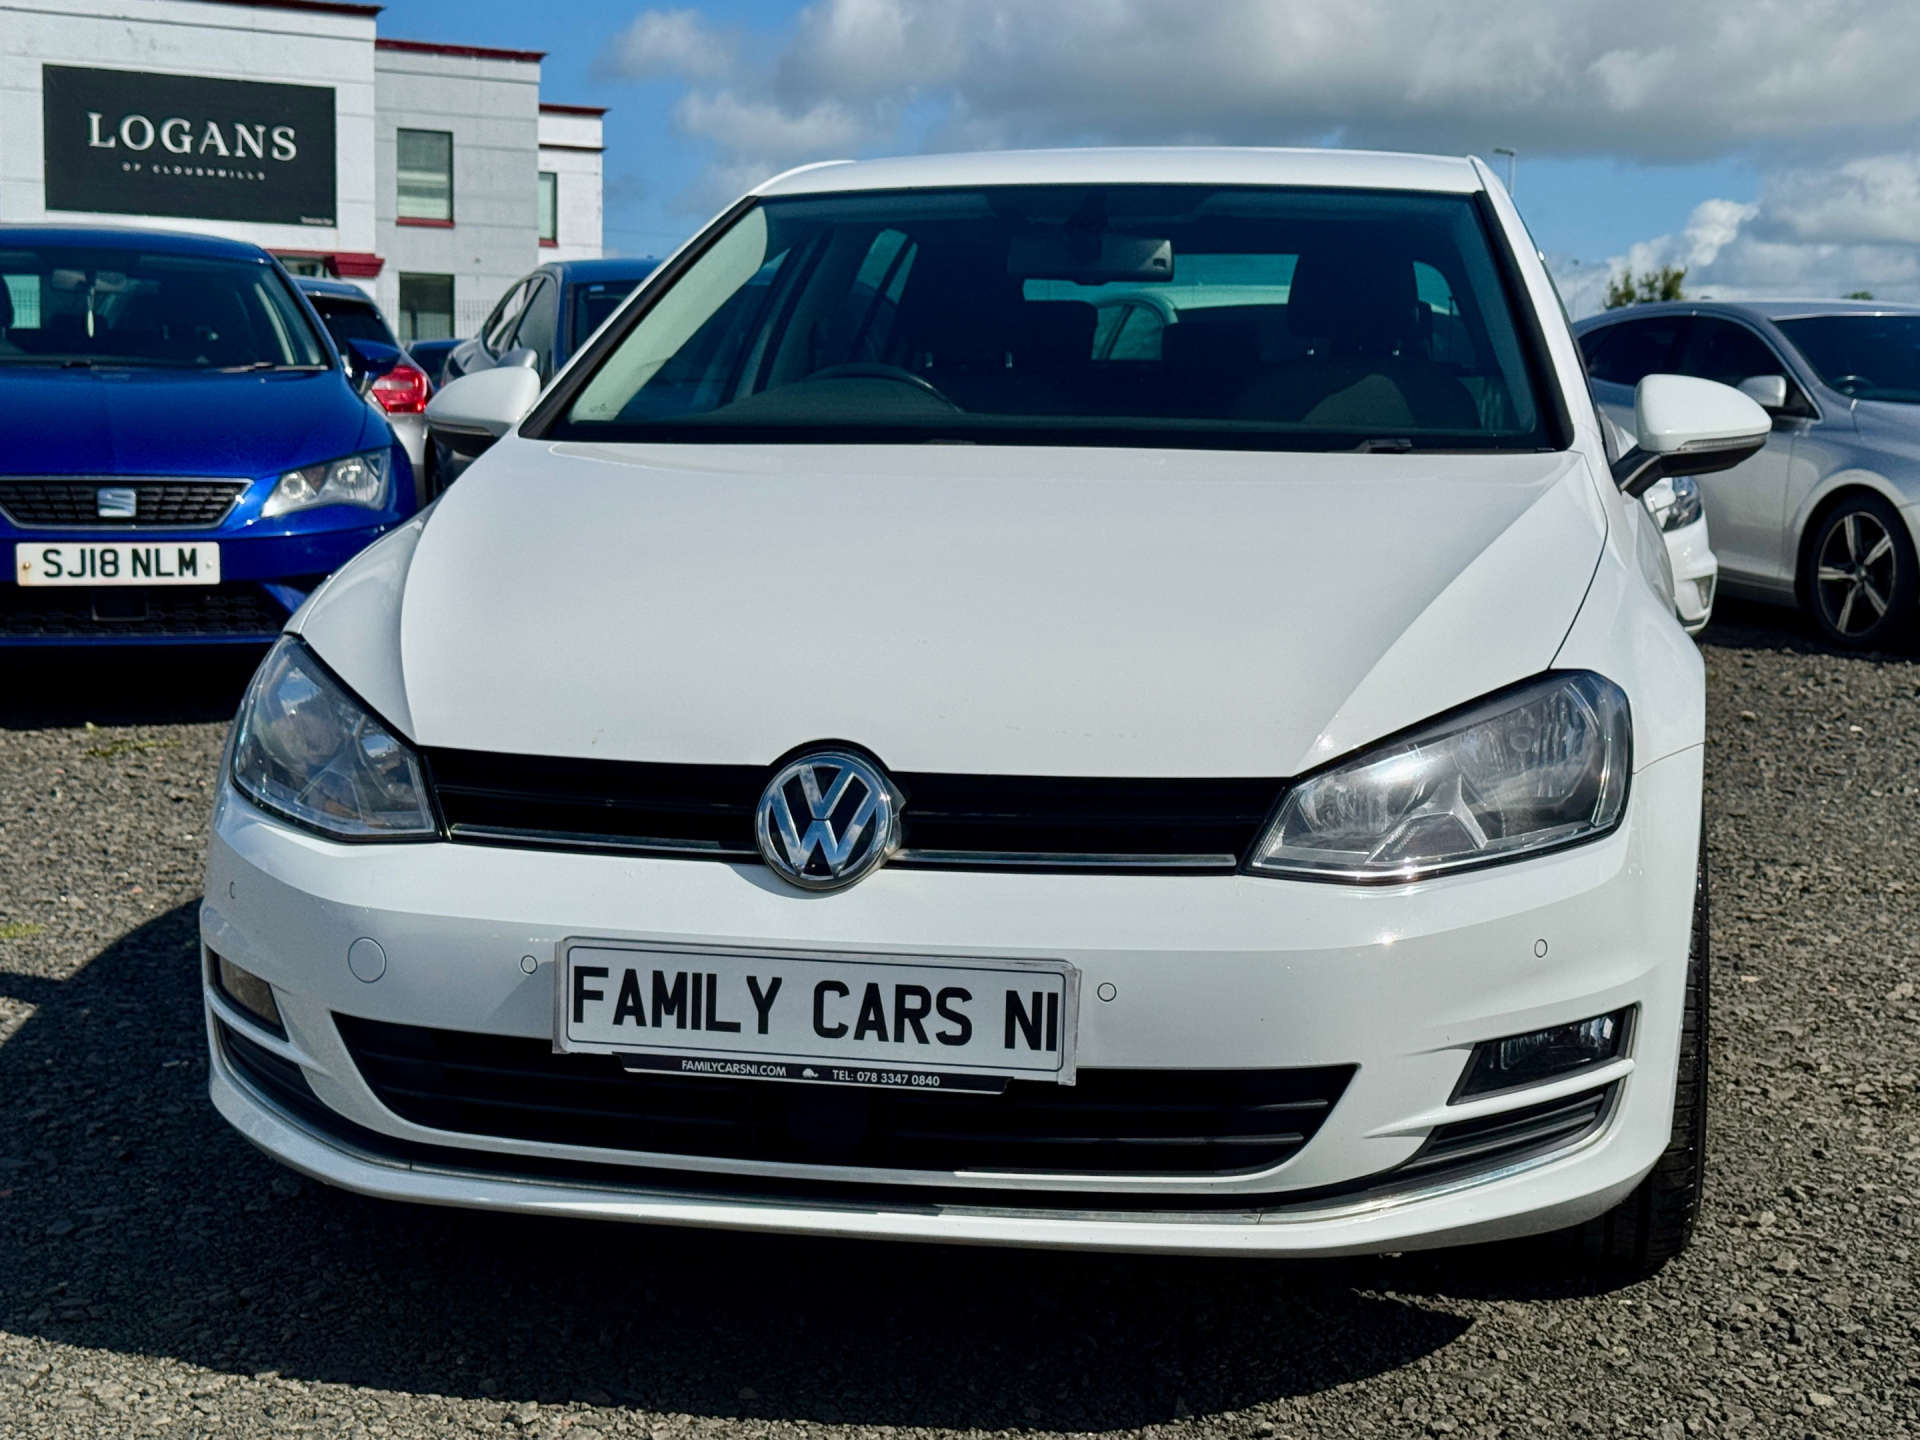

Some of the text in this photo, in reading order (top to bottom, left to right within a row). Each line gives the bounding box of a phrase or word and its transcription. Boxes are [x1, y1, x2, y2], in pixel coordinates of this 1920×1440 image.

[88, 112, 297, 161] LOGANS
[122, 162, 141, 171] OF
[42, 548, 198, 578] SJ18 NLM
[573, 966, 1059, 1052] FAMILY CARS NI
[681, 1059, 787, 1077] FAMILYCARSNI.COM
[832, 1069, 940, 1087] TEL: 078 3347 0840
